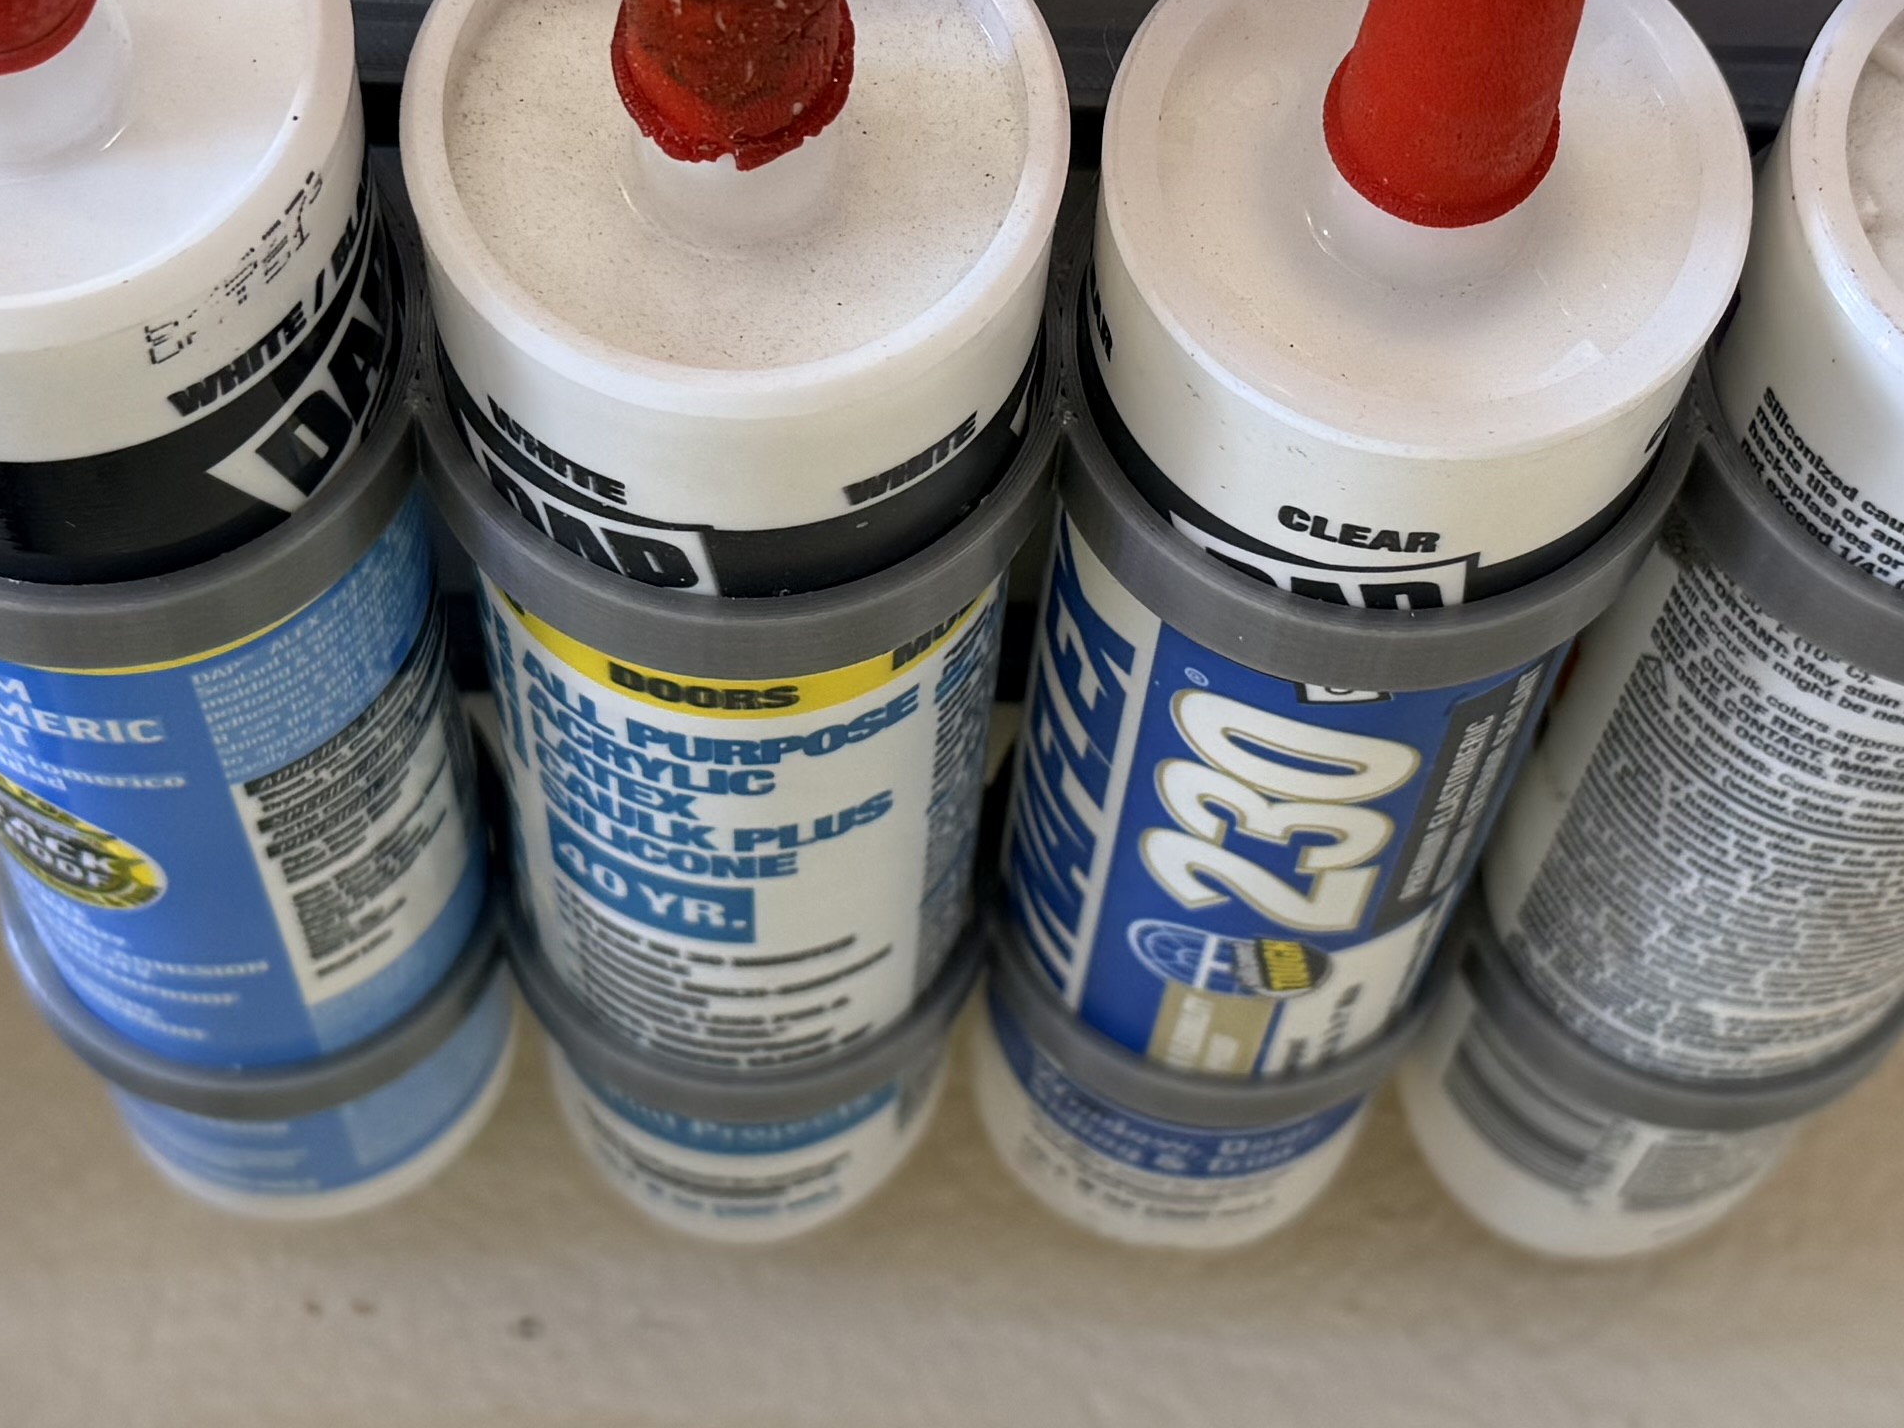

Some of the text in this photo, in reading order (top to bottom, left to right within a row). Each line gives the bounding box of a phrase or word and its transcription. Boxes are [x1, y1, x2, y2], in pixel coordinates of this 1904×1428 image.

[167, 301, 307, 417] WHITE
[487, 393, 627, 505] WHITE
[842, 410, 978, 506] WHITE
[1747, 419, 1873, 555] backsplashes
[1878, 551, 1904, 572] or
[1756, 405, 1803, 474] meets
[1806, 472, 1837, 508] tile
[1842, 507, 1869, 530] or
[1764, 386, 1859, 503] Siliconized
[1278, 505, 1440, 552] CLEAR
[1741, 438, 1765, 477] not
[1766, 477, 1834, 547] exceed
[1839, 545, 1891, 578] 1/4"
[523, 649, 919, 765] ALL PURPOSE
[528, 683, 776, 796] ACRYLIC
[608, 661, 800, 709] DOORS
[532, 712, 700, 821] LATEX
[535, 740, 893, 852] CAULK PLUS
[1137, 686, 1424, 935] 230
[540, 770, 799, 879] SILICONE
[557, 841, 748, 930] 40 YR.
